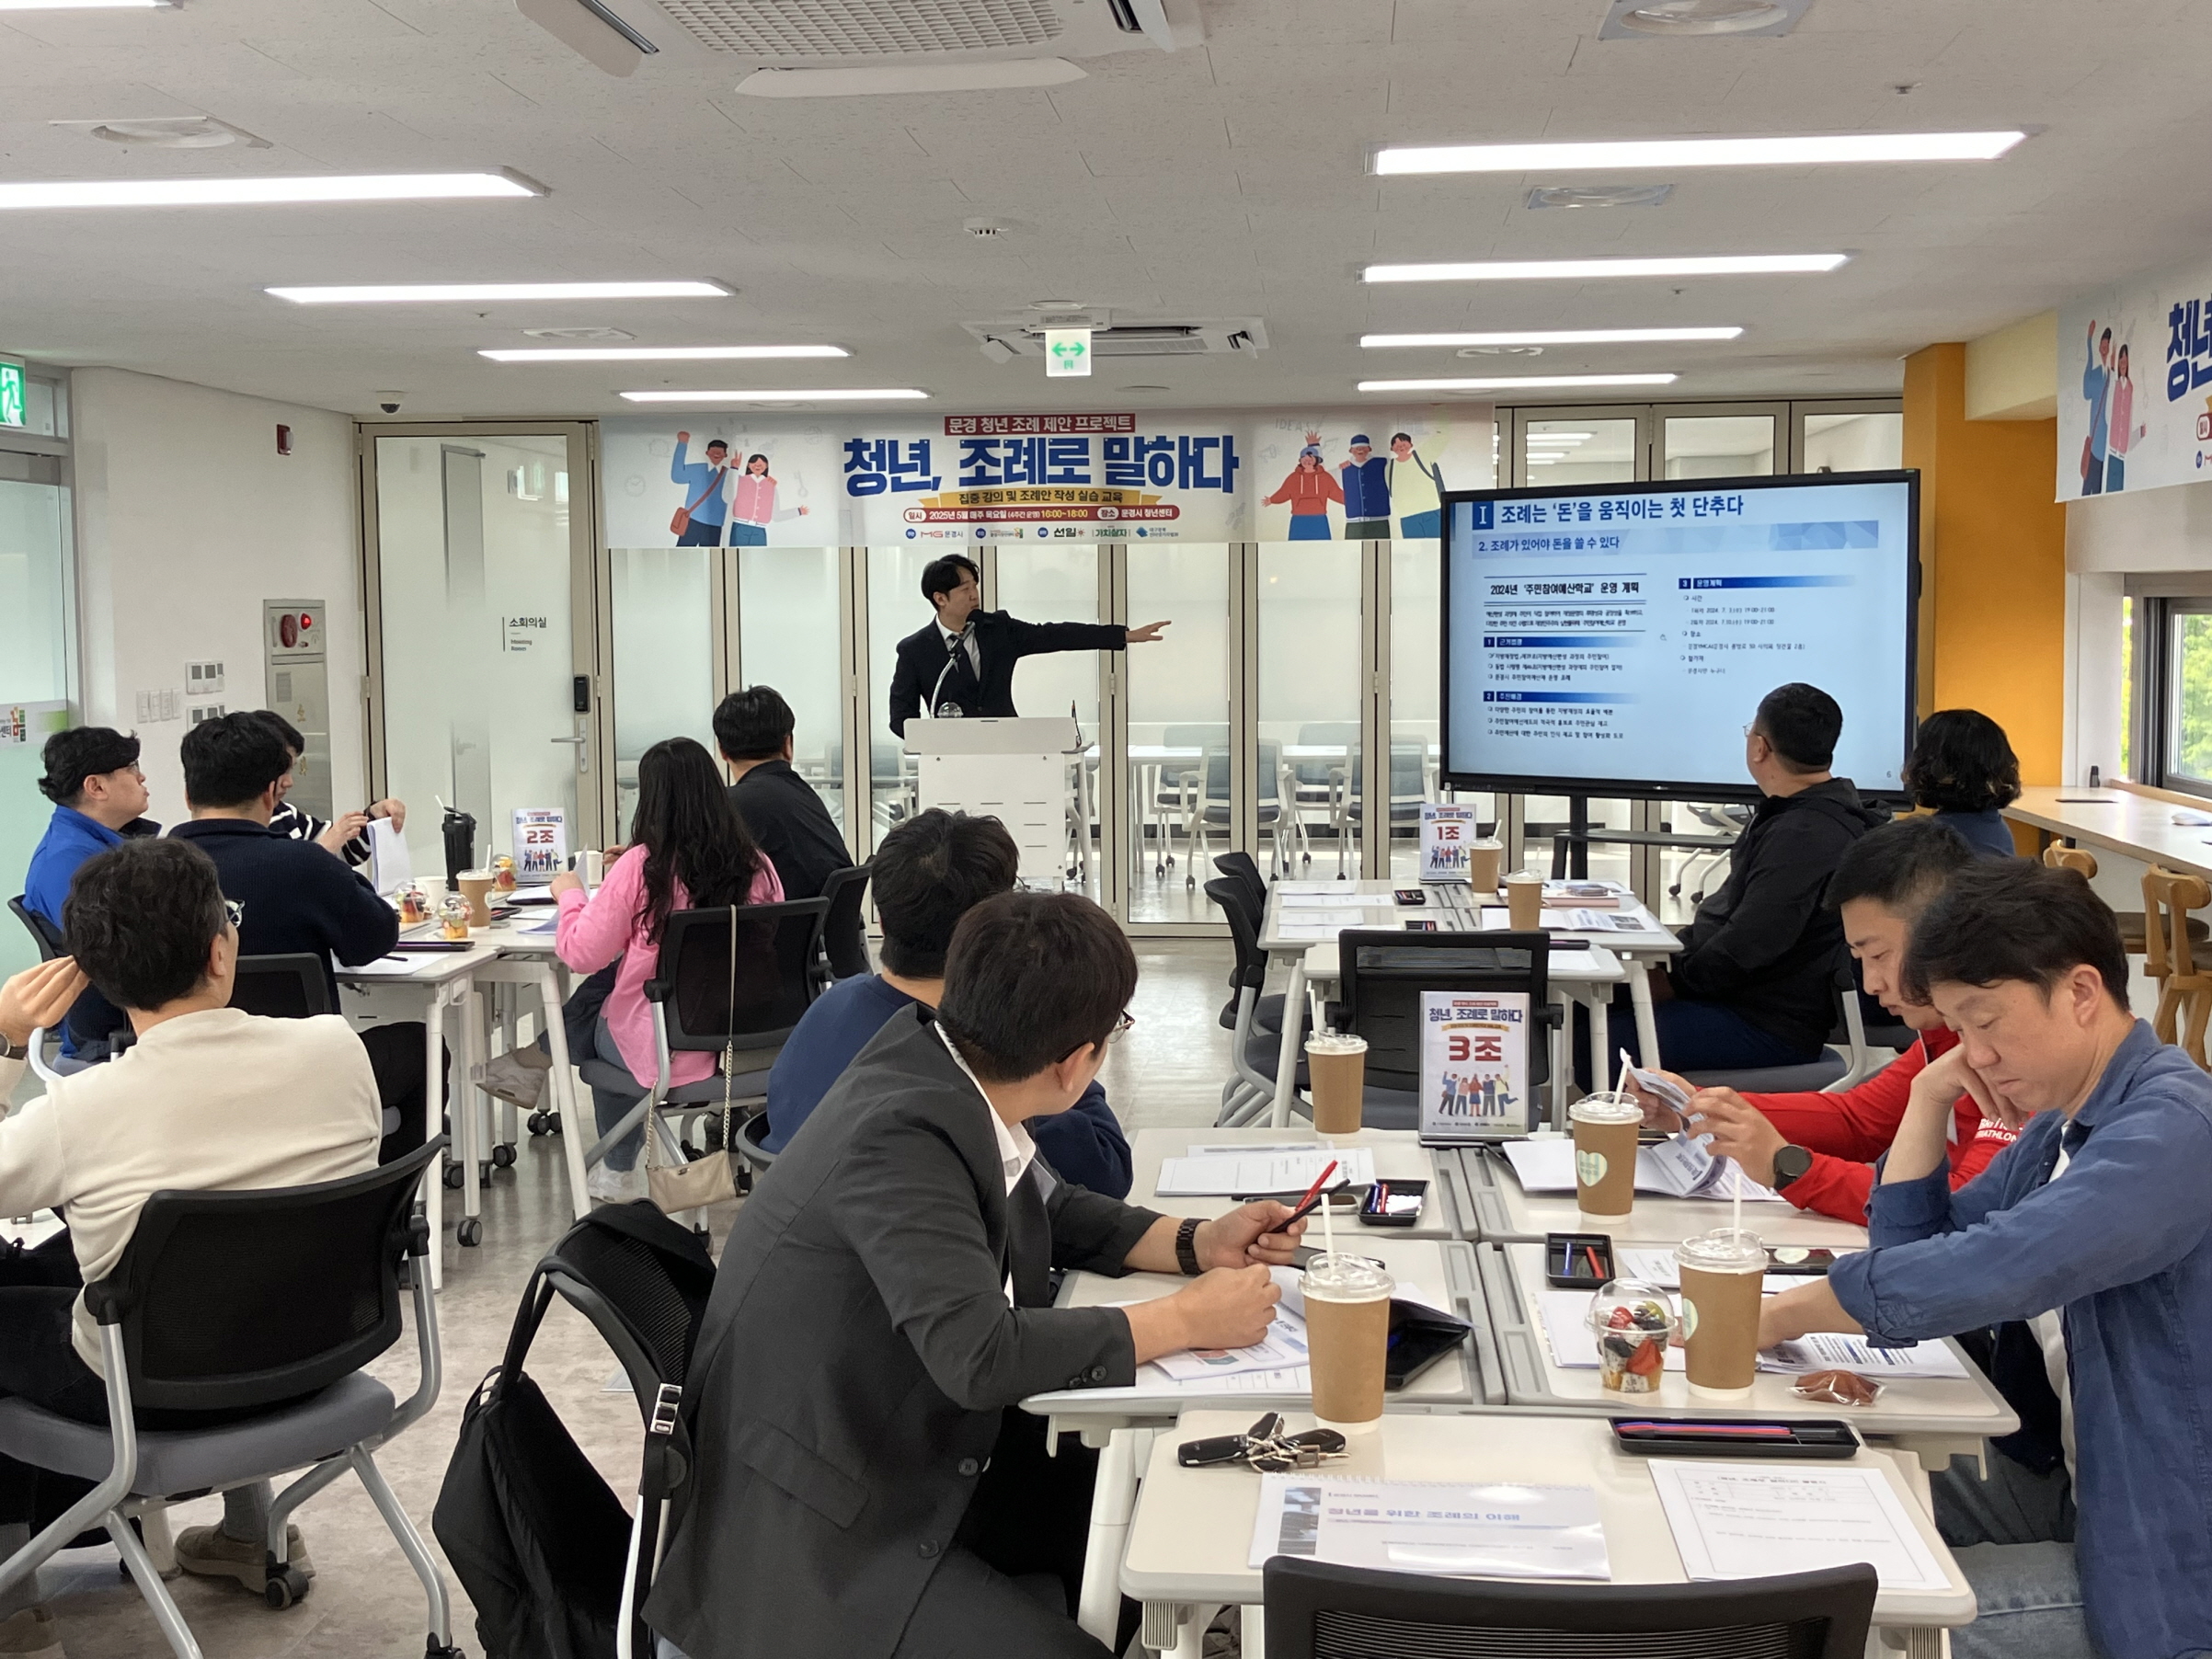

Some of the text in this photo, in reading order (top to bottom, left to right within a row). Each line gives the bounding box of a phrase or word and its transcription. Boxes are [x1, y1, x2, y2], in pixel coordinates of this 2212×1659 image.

[948, 416, 1132, 434] 문경 청년 조례 제안 프로젝트
[843, 435, 1240, 497] 청년, 조례로 말하다
[958, 489, 1124, 504] 집중 강의 및 조례안 작성 실습 교육
[909, 511, 922, 521] 일시
[929, 511, 955, 521] 2025년
[986, 509, 1006, 519] 목요일
[1041, 509, 1088, 519] 16:00~18:00
[1100, 509, 1116, 518] 장소
[1121, 509, 1142, 517] 문경시
[1144, 509, 1172, 517] 청년센터
[1501, 504, 1547, 524] 조례는
[1599, 498, 1663, 521] 움직이는
[1670, 497, 1685, 518] 첫
[1692, 495, 1744, 517] 단추다
[1054, 528, 1076, 537] 선일
[1479, 536, 1620, 552] 2. 조례가 있어야 돈을 쓸 수 있다
[1490, 584, 1518, 595] 2024년
[1600, 582, 1617, 593] 운영
[1622, 581, 1639, 593] 계획
[509, 616, 546, 628] 소회의실
[526, 830, 554, 844] 2조
[1437, 826, 1460, 841] 1조
[1456, 1008, 1488, 1021] 조례로
[1490, 1008, 1523, 1023] 말하다
[1449, 1035, 1502, 1061] 3조
